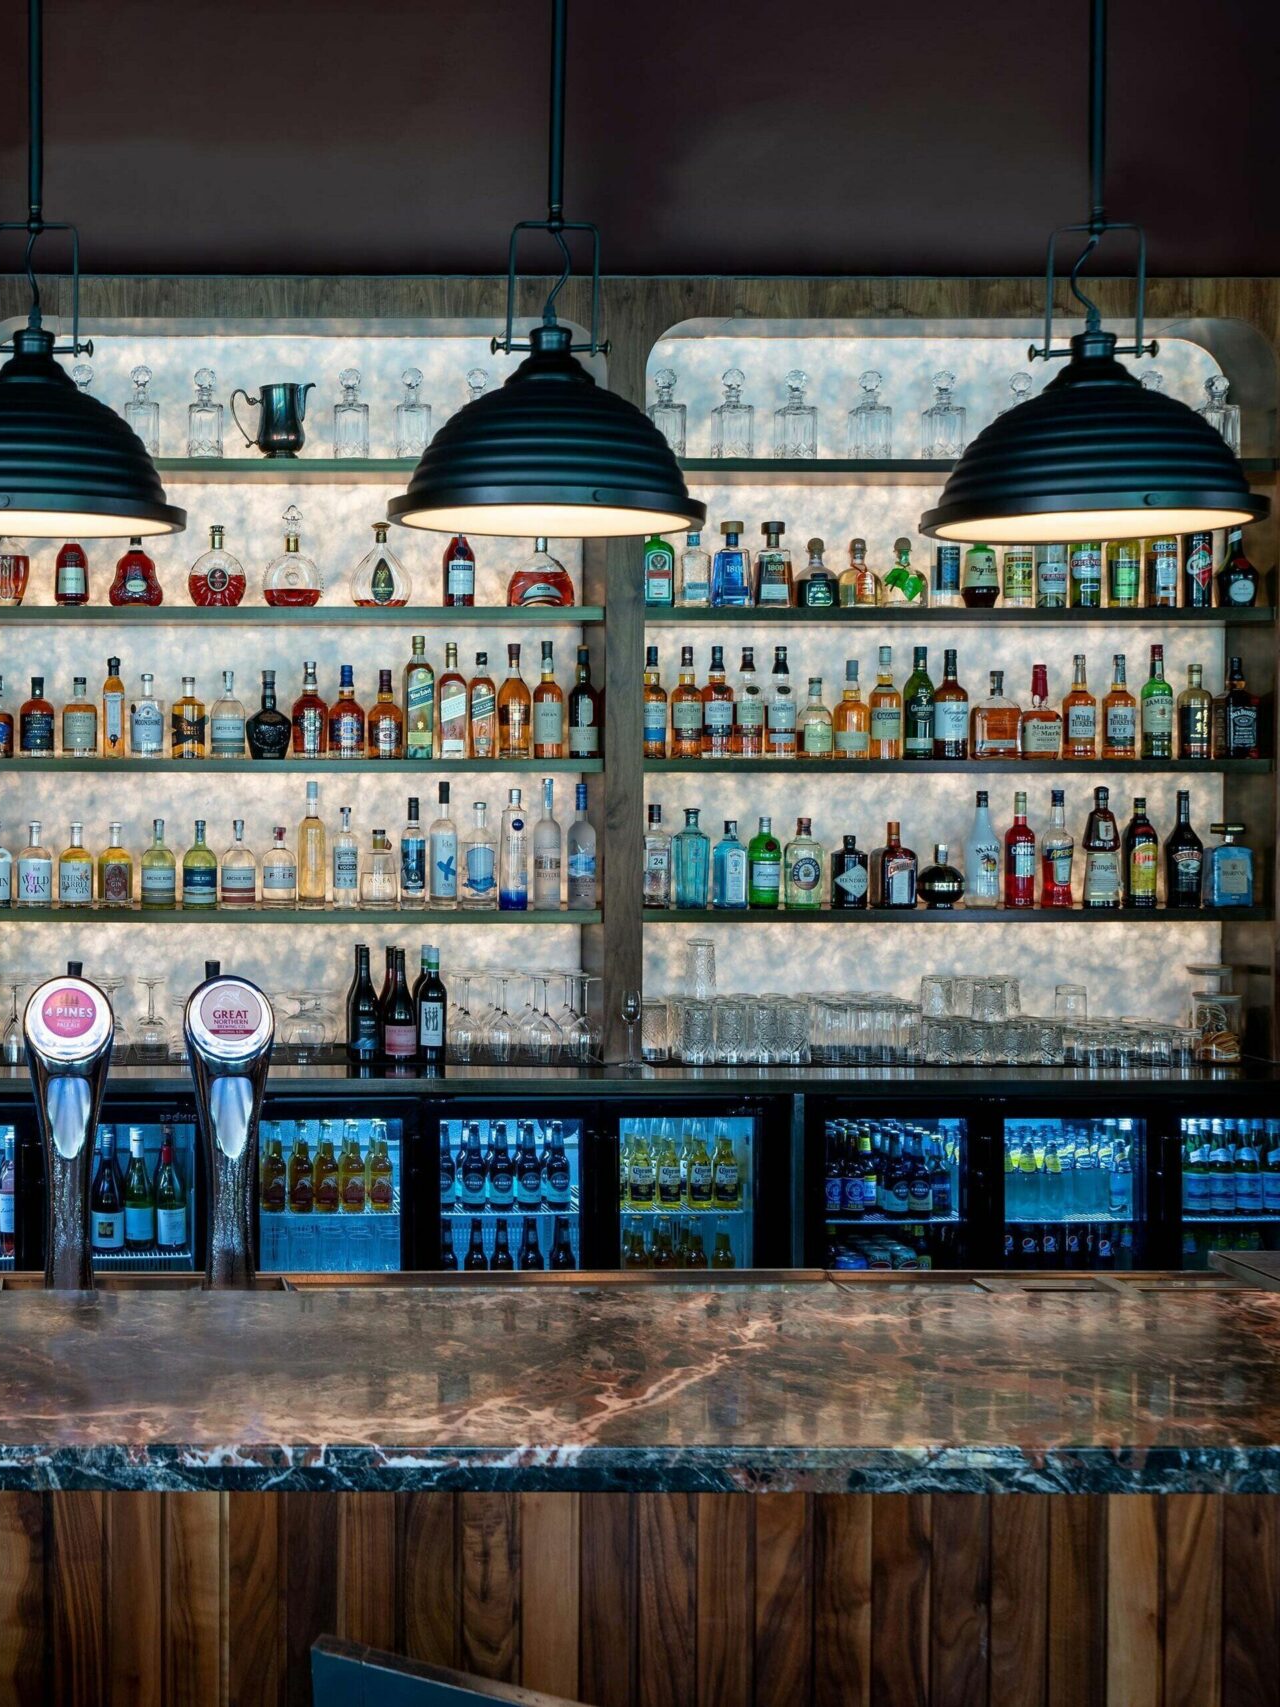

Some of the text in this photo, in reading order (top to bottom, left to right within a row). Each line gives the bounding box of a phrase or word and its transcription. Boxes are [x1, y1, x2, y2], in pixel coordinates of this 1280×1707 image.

[1011, 846, 1035, 855] CAMPA
[22, 875, 49, 885] WILD
[25, 884, 45, 894] GIN
[45, 1007, 94, 1018] 4 PINES
[212, 1010, 249, 1019] GREAT
